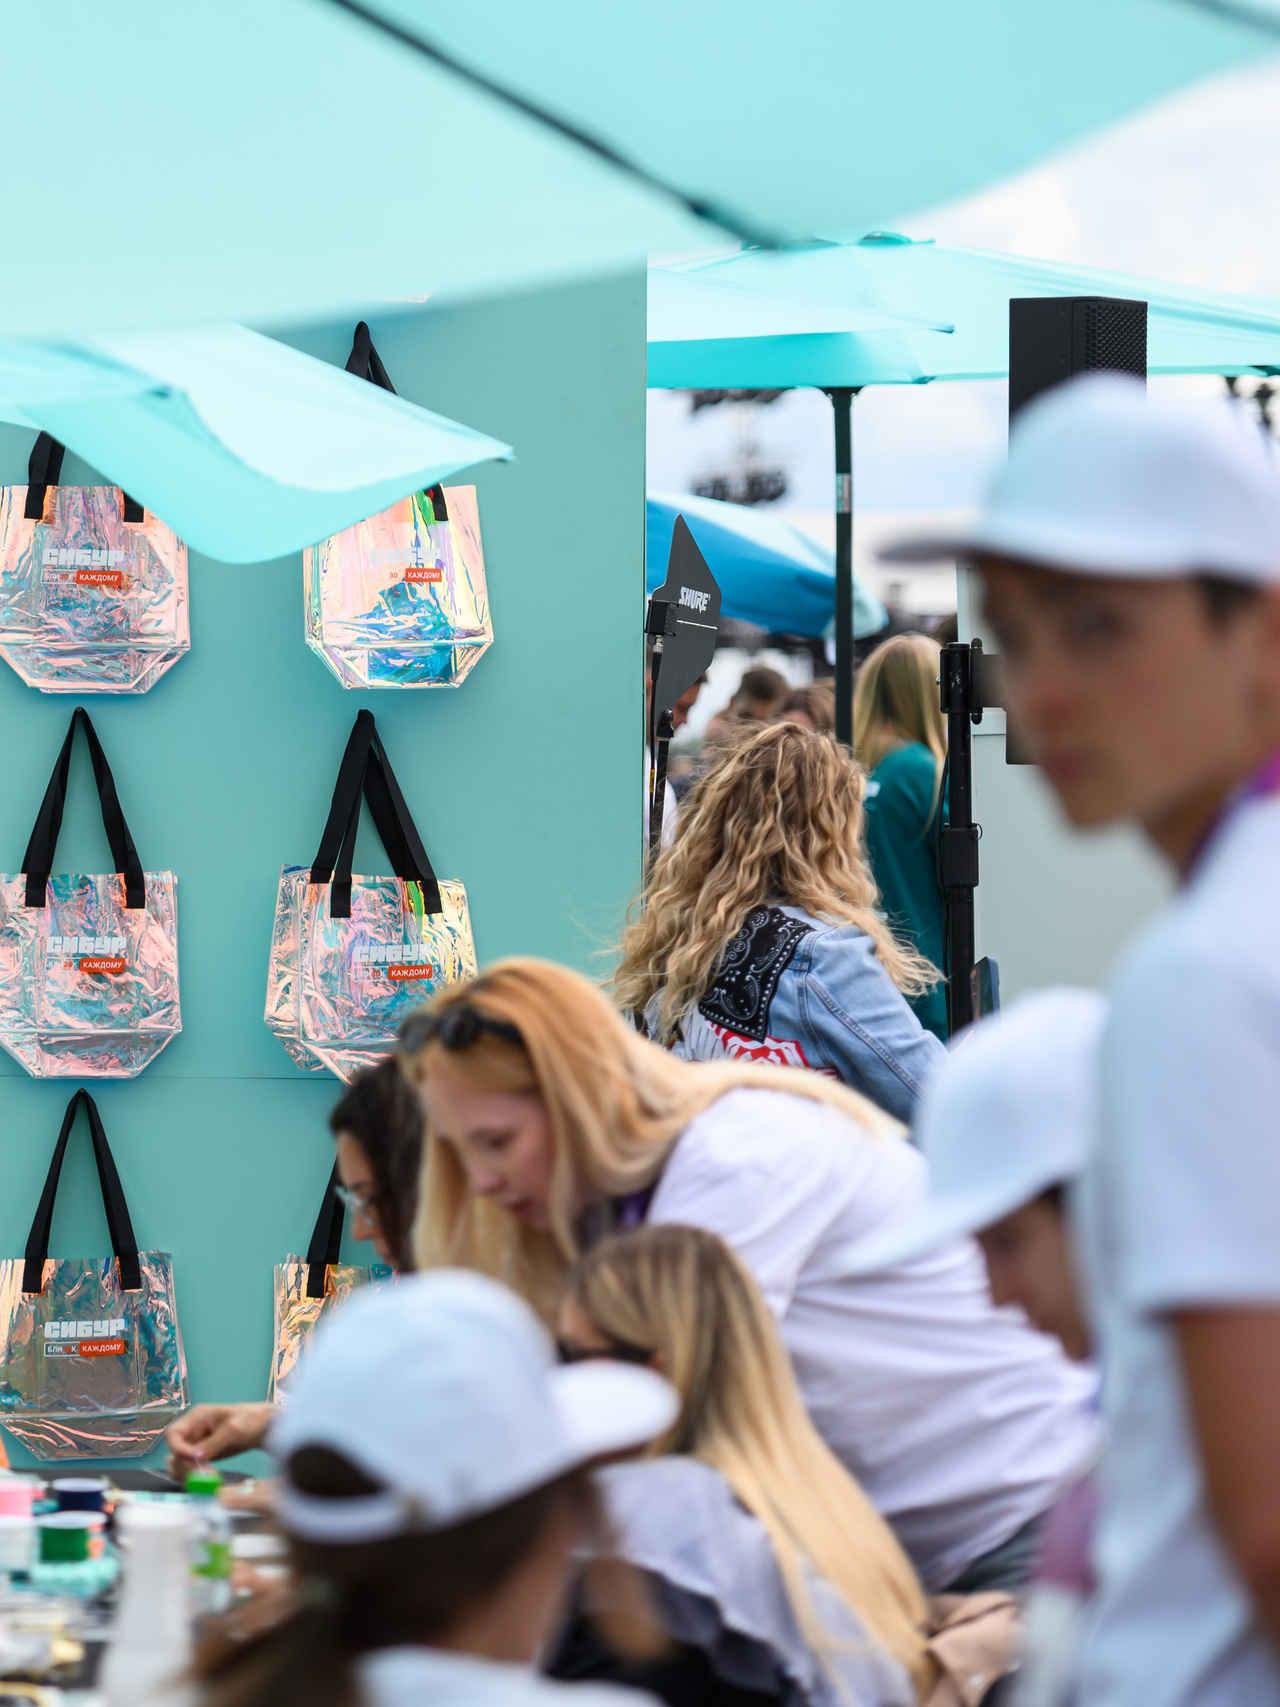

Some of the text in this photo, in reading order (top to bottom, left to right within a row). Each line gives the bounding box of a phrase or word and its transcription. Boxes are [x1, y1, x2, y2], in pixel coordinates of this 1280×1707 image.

[42, 548, 125, 566] СИБУР
[79, 574, 119, 582] КАЖДОМУ
[407, 571, 440, 580] КАЖДОМУ
[678, 586, 709, 614] SHURE
[46, 936, 127, 954] СИБУР
[353, 943, 432, 963] СИБУР
[83, 961, 122, 970] КАЖДОМУ
[391, 968, 430, 978] КАЖДОМУ
[44, 1318, 125, 1339] СИБУР
[82, 1343, 121, 1353] КАЖДОМУ
